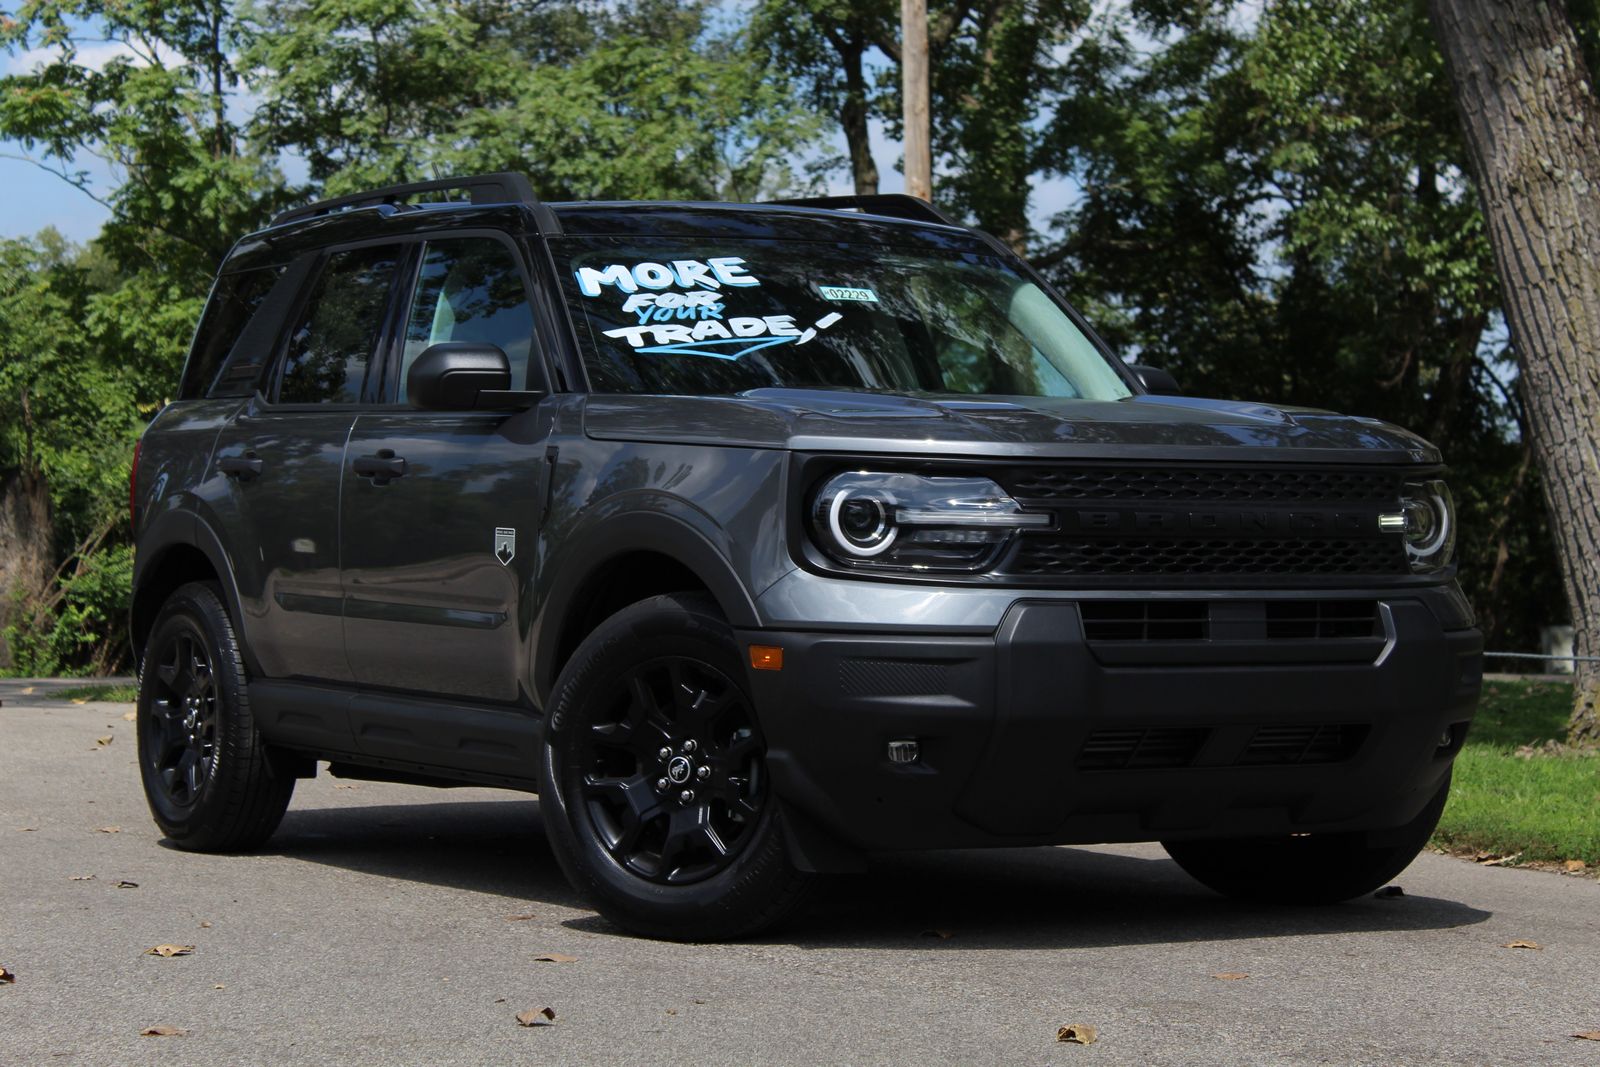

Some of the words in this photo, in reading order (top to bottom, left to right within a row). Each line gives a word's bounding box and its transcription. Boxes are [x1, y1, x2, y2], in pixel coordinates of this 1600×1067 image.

[574, 256, 761, 297] MORE
[621, 290, 723, 313] FOR
[634, 302, 726, 325] YOUR
[1078, 510, 1372, 531] BRONCO
